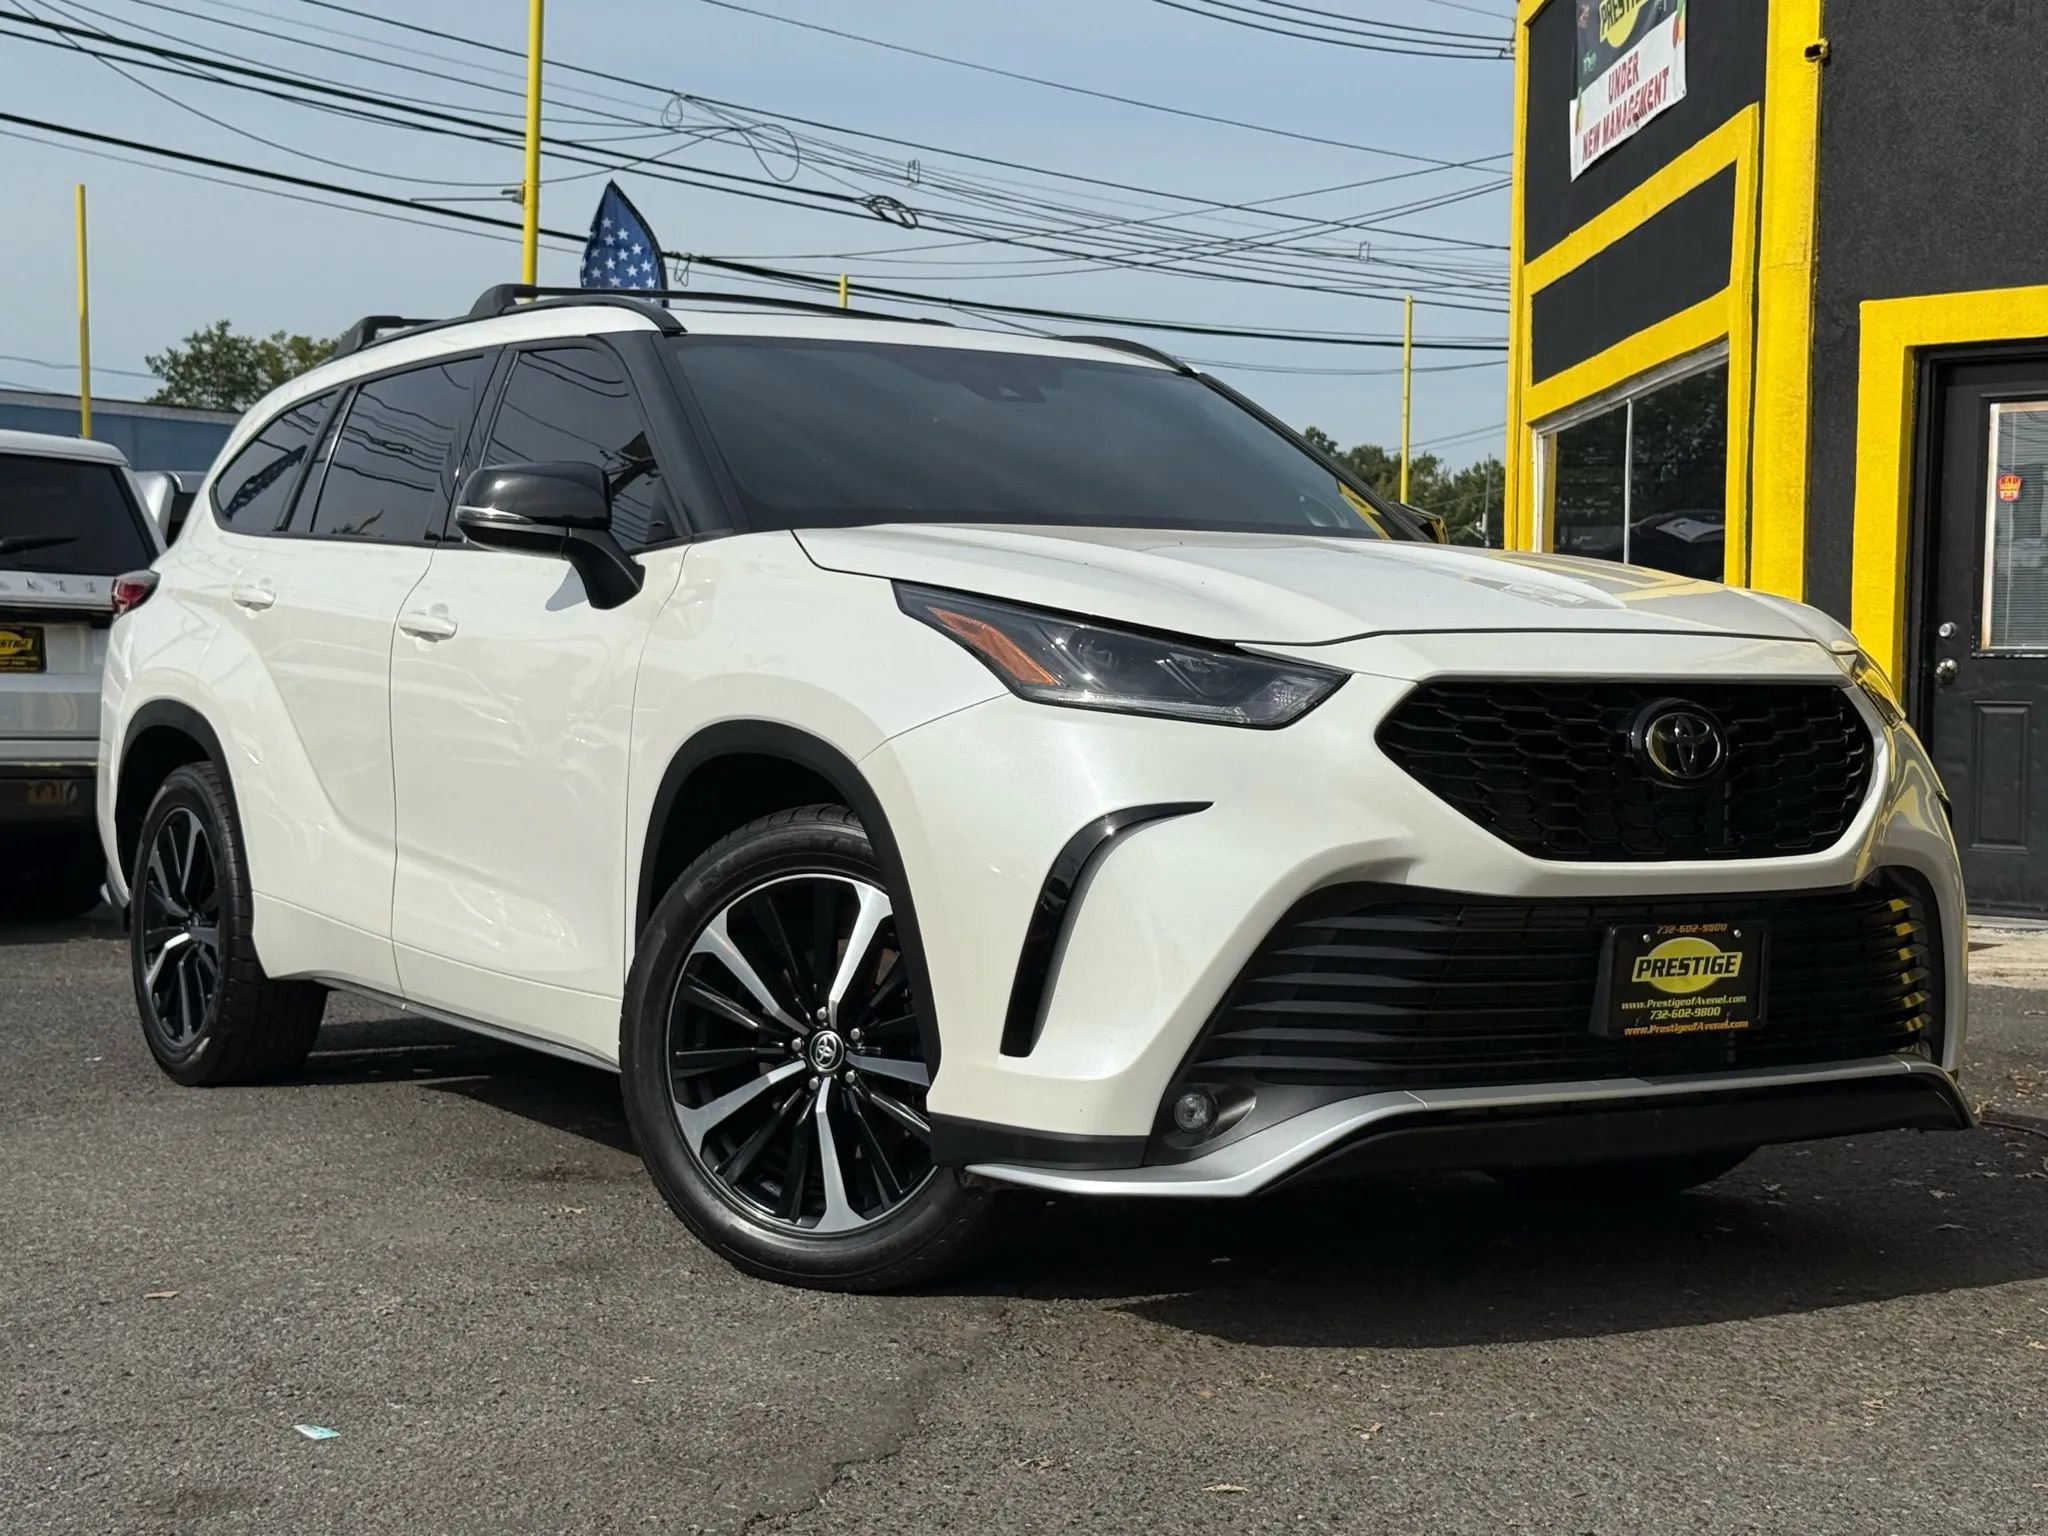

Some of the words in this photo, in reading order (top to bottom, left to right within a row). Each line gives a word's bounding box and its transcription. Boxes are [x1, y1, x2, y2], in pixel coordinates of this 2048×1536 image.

[1608, 51, 1640, 105] UNDER
[1582, 119, 1601, 164] NEW
[1602, 65, 1669, 147] MANAGEMENT
[1657, 923, 1728, 934] 732-602-9800
[1635, 954, 1737, 978] PRESTIGE
[1621, 995, 1747, 1010] www.PrestigeofAvenel.com
[1650, 1006, 1721, 1020] 732-602-9800
[1624, 1020, 1749, 1034] www.PrestigeofAvenel.com
